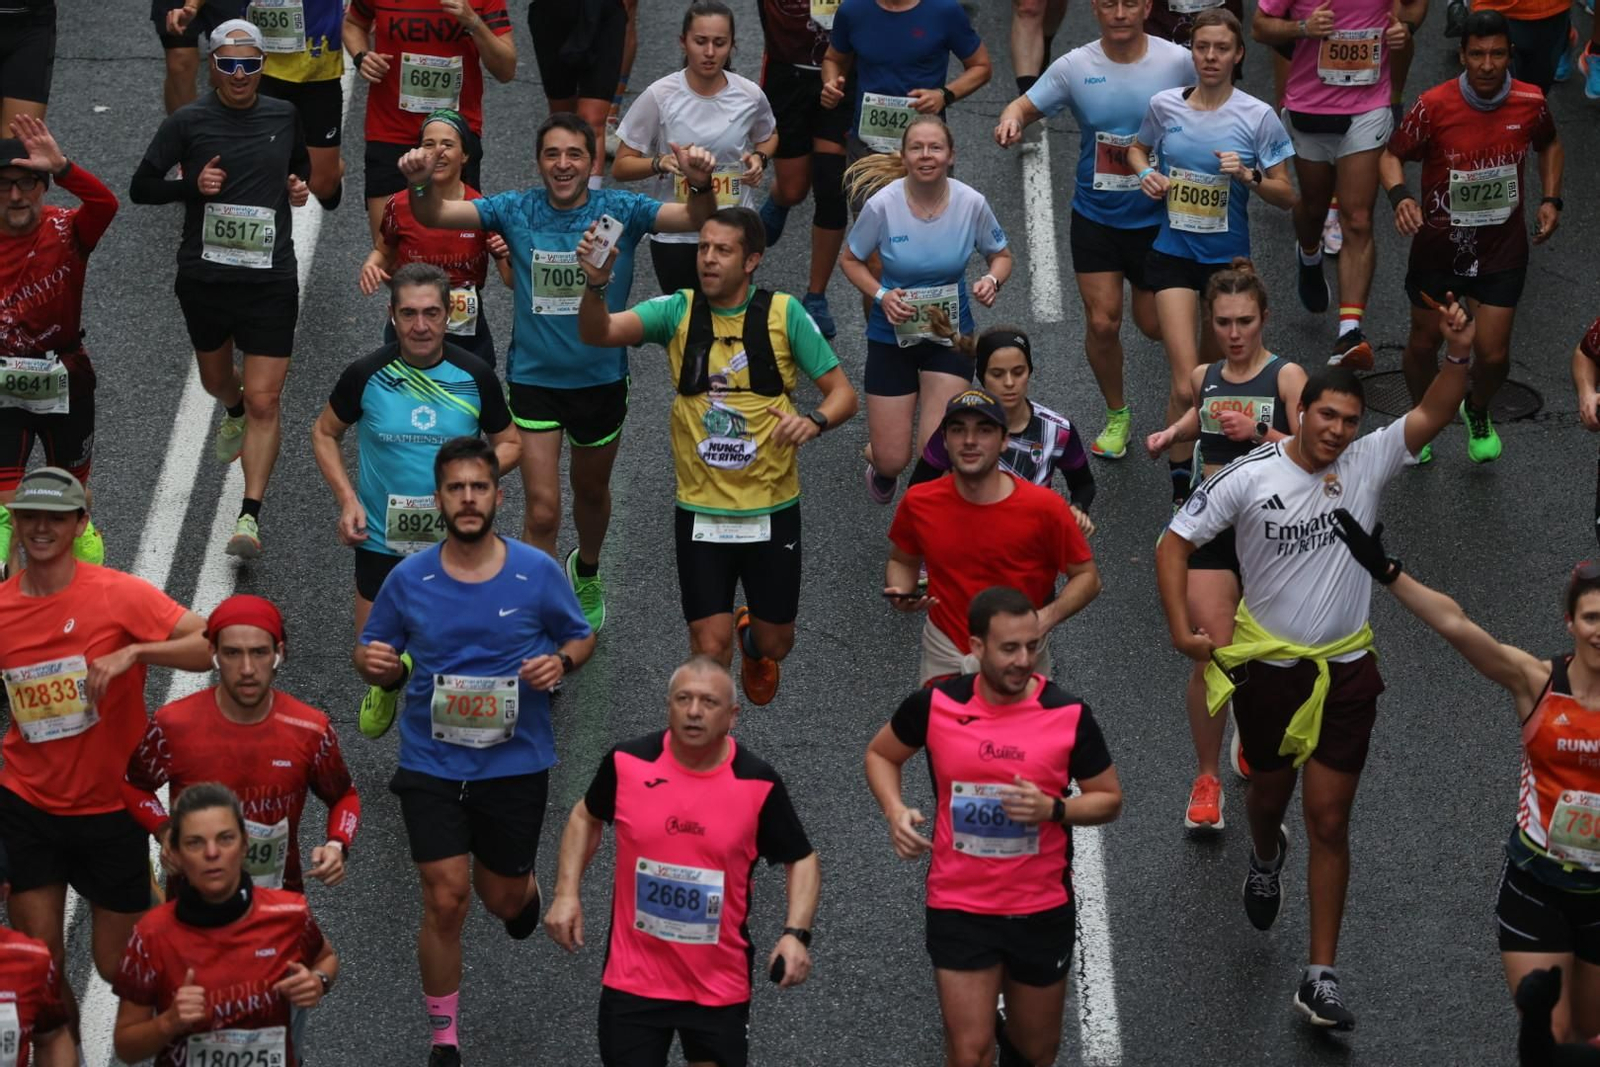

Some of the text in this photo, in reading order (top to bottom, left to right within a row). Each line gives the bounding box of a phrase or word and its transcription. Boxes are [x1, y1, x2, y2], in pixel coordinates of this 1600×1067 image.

[389, 17, 473, 44] KENYA
[1328, 43, 1369, 61] 5083
[410, 69, 451, 89] 6879
[1084, 76, 1106, 86] HOKA
[869, 109, 908, 129] 8342
[1472, 150, 1525, 170] MARAT
[680, 176, 730, 196] 191
[1172, 184, 1219, 207] 15089
[1460, 182, 1503, 204] 9722
[214, 219, 259, 241] 6517
[889, 234, 909, 243] HOKA
[541, 268, 585, 288] 7005
[5, 374, 51, 392] 8641
[702, 452, 751, 462] ME RINDO
[709, 442, 744, 453] NUNCA
[398, 513, 446, 532] 8924
[1264, 511, 1340, 541] Emirate
[1300, 531, 1337, 553] BETTER
[15, 677, 77, 709] 12833
[445, 695, 499, 717] 7023
[1556, 738, 1600, 753] RUNN
[965, 803, 1014, 827] 266
[246, 844, 272, 864] 49
[647, 881, 700, 911] 2668
[197, 1050, 268, 1067] 18025
